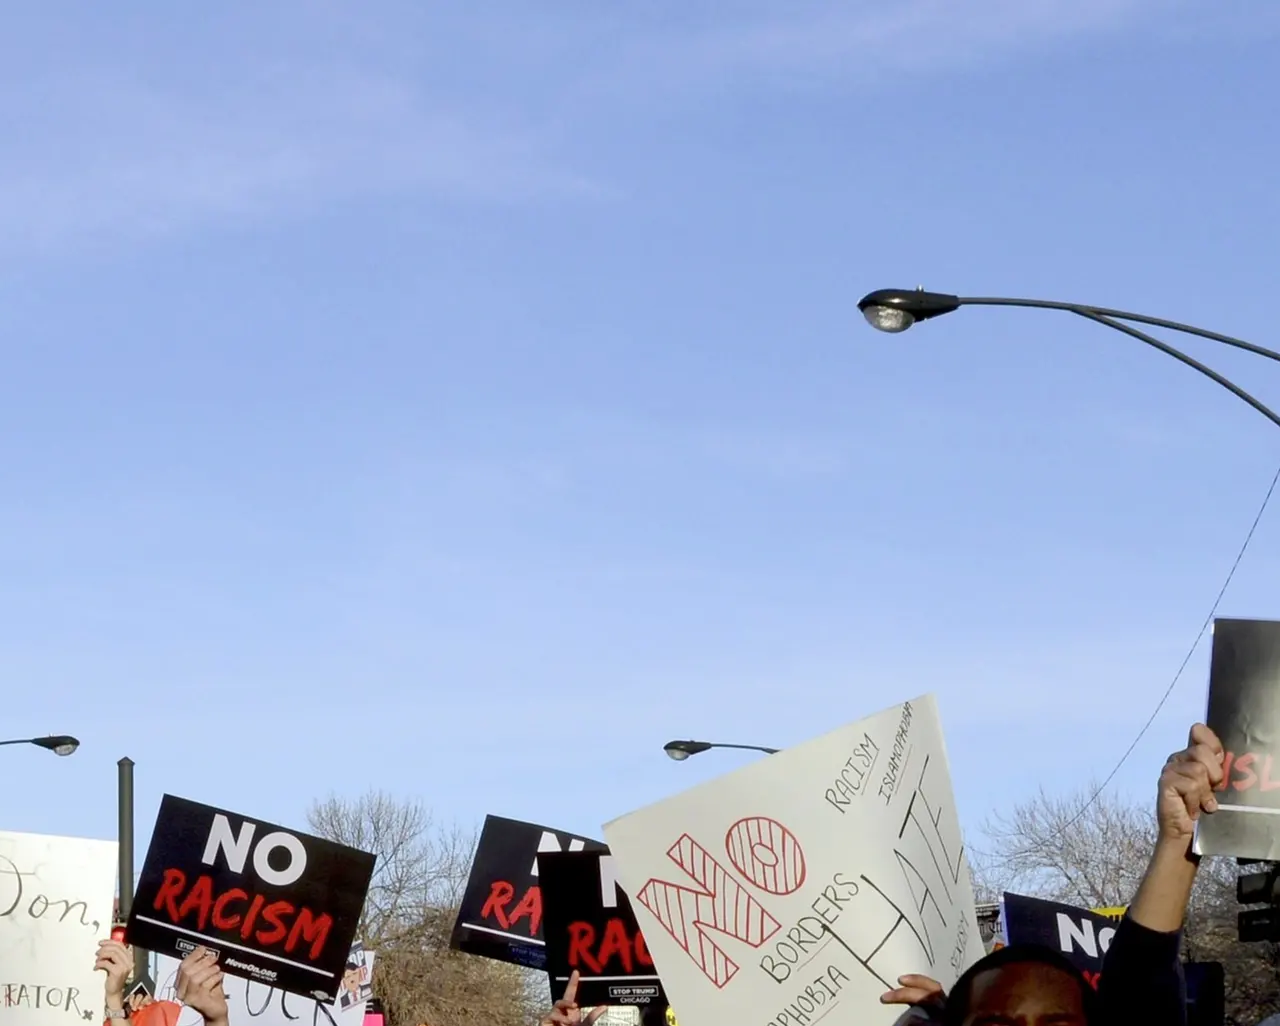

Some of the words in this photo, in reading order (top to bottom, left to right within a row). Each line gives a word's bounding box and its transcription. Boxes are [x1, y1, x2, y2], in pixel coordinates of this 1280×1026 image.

[825, 733, 880, 814] RACISM
[878, 701, 915, 806] ISLAMOPHOBIA
[201, 813, 307, 886] NO
[820, 755, 965, 991] HATE
[153, 868, 333, 961] RACISM
[636, 816, 807, 989] NO
[760, 872, 860, 984] BORDERS
[620, 996, 650, 1004] CHICAGO
[632, 987, 656, 995] TRUMP
